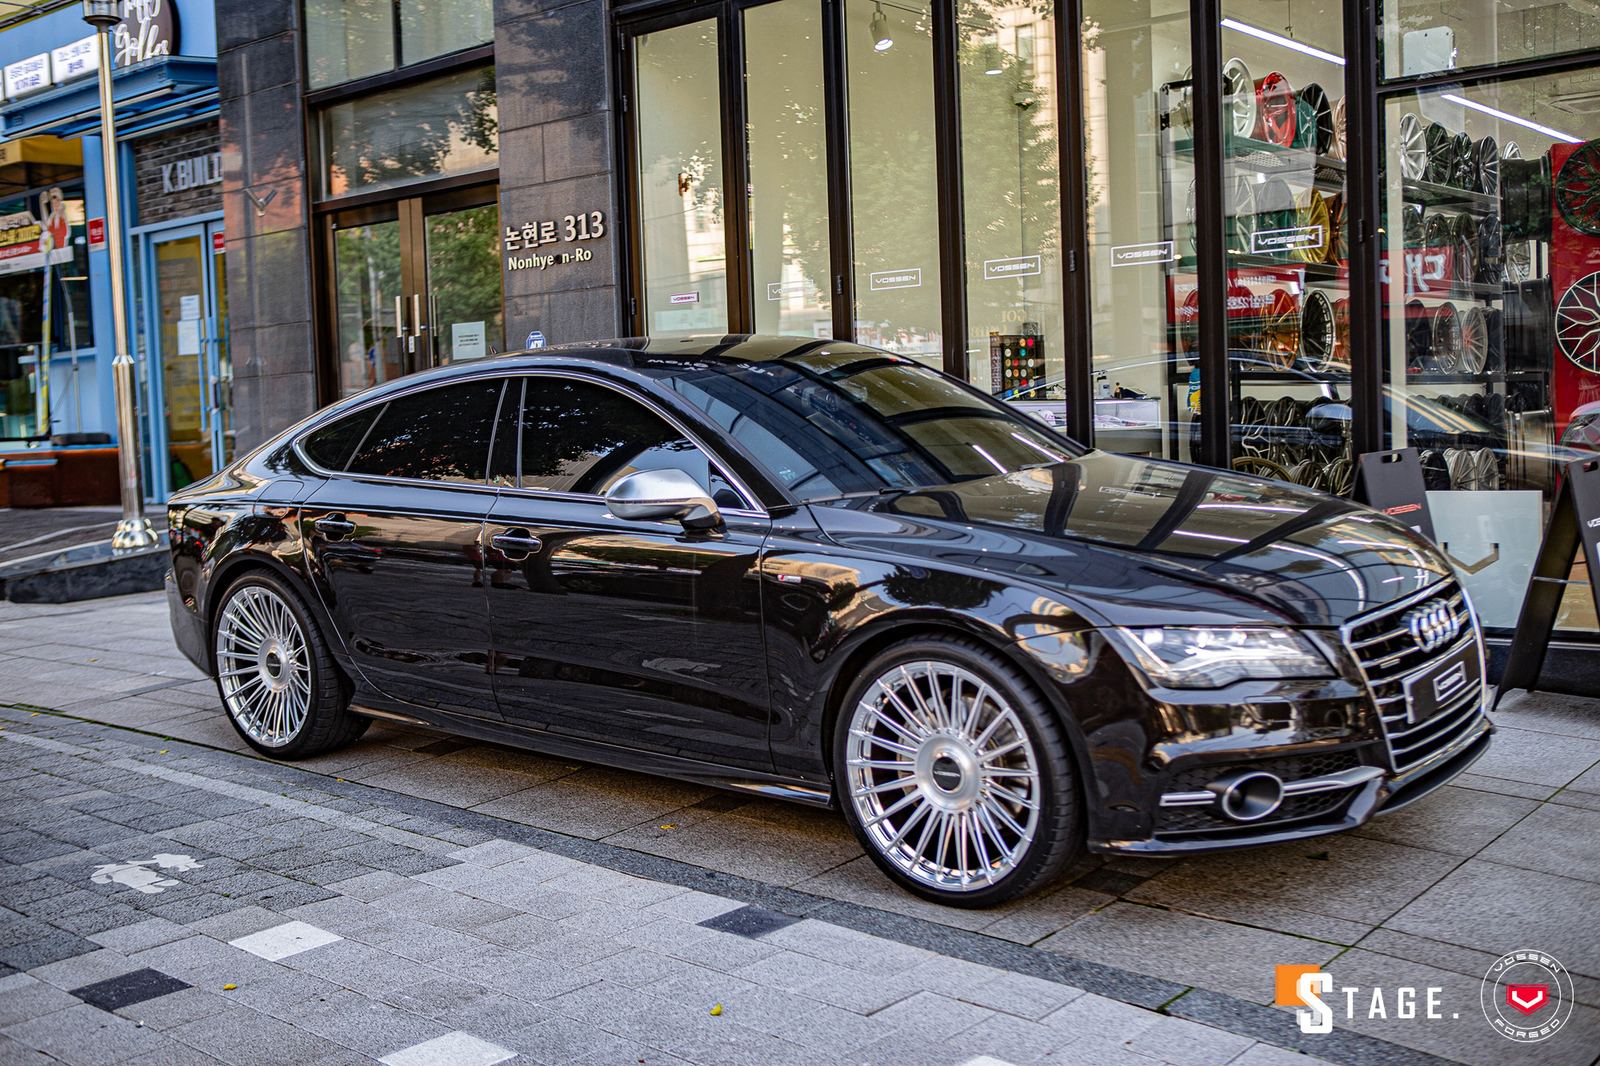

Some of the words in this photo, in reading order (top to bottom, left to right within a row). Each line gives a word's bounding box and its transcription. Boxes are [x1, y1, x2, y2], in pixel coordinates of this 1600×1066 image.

[505, 221, 557, 251] 논현로
[564, 210, 604, 242] 313
[1257, 233, 1316, 246] VOSSEN
[1117, 248, 1168, 259] VOSSEN
[989, 262, 1036, 272] VOSSEN
[875, 274, 916, 284] VOSSEN
